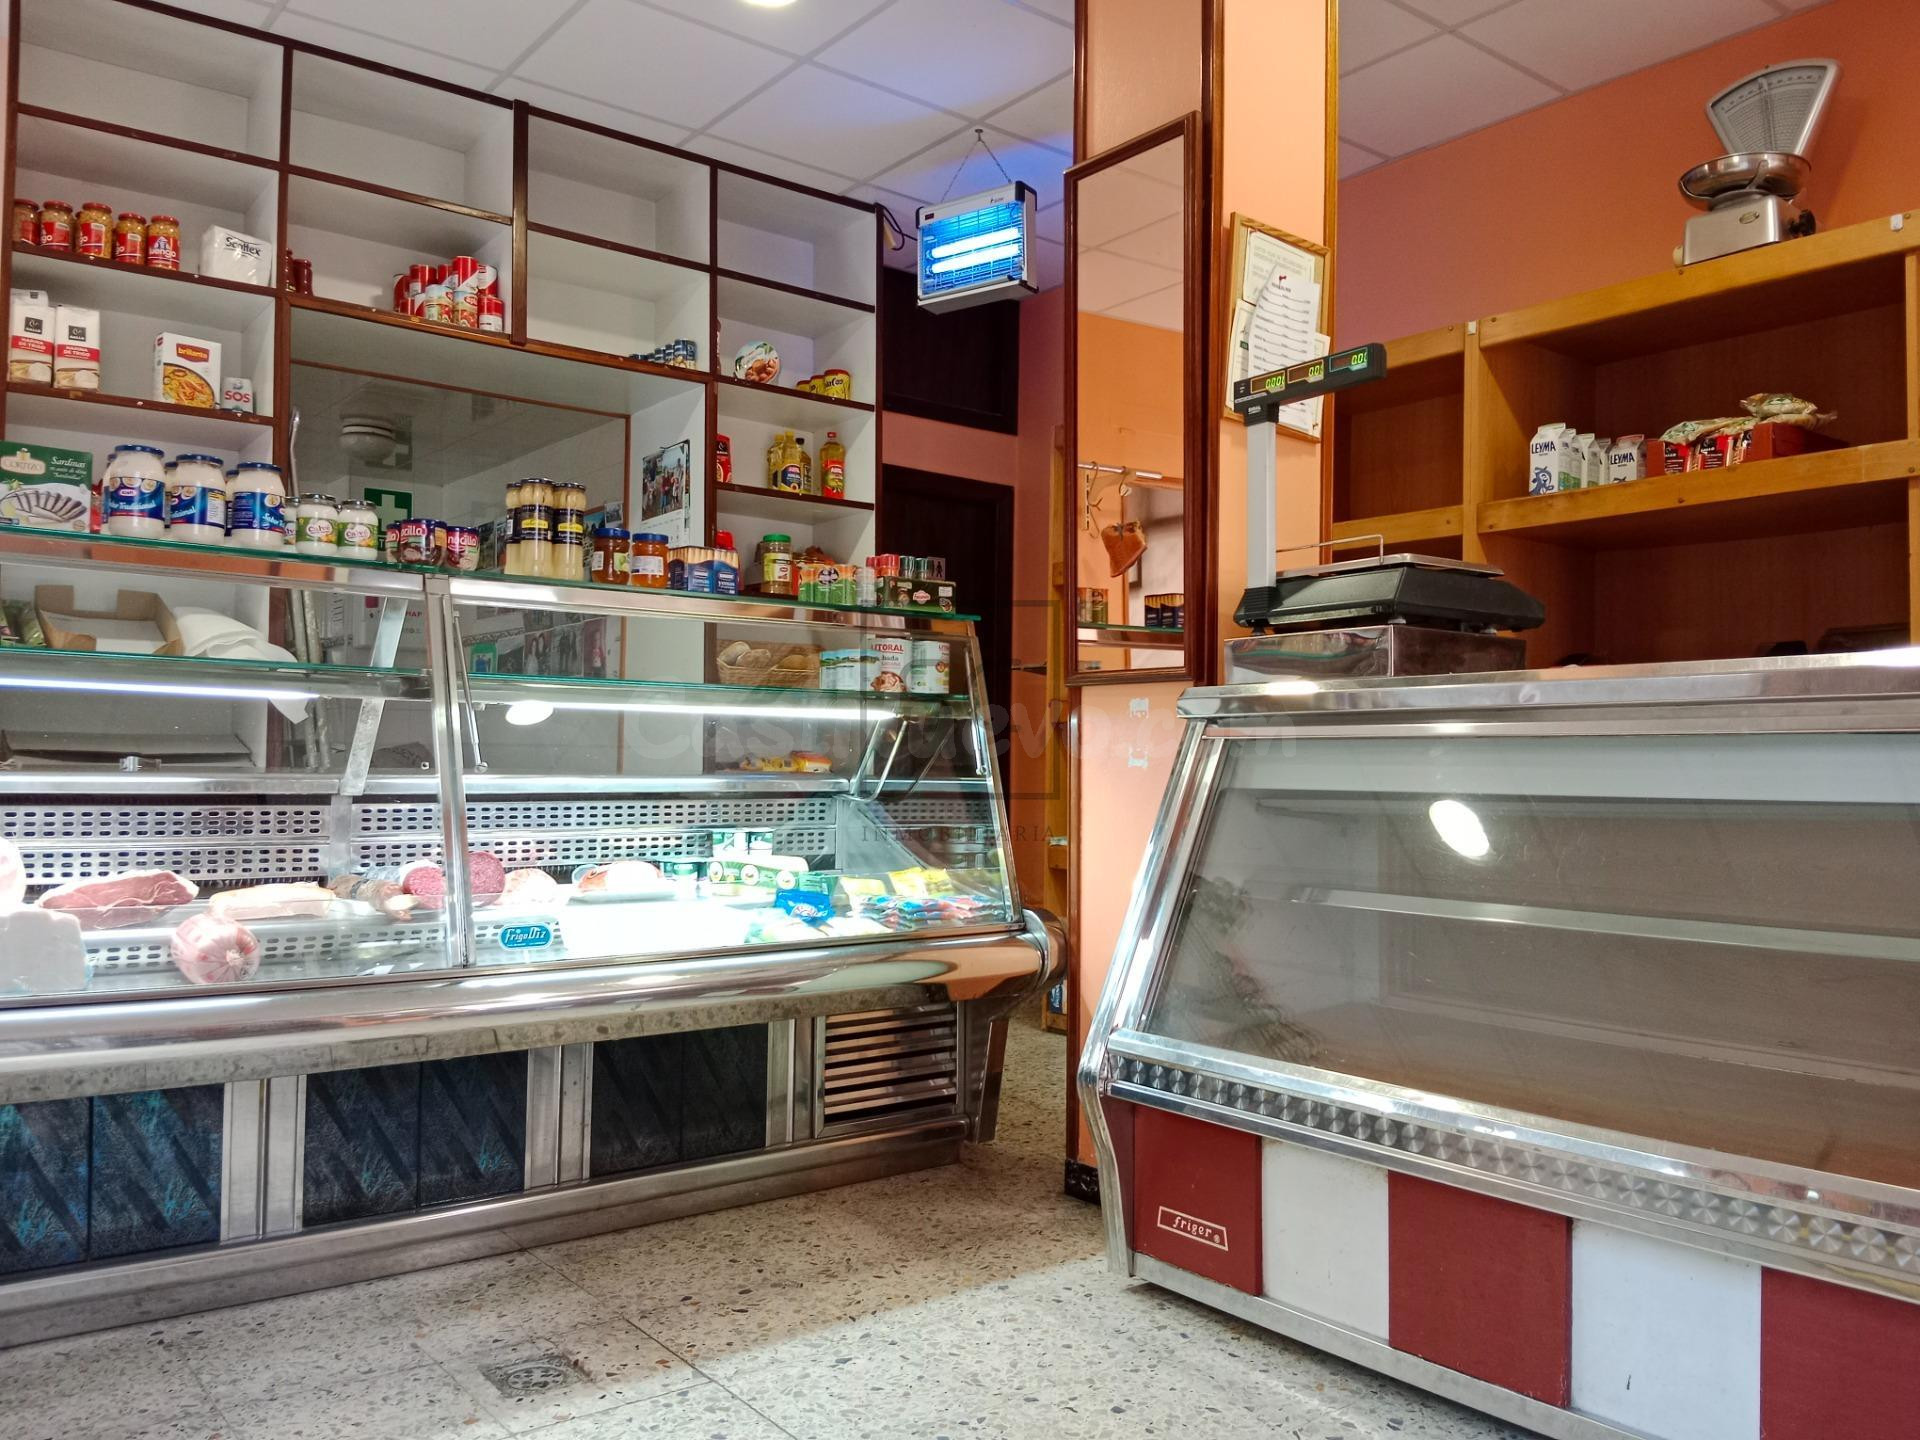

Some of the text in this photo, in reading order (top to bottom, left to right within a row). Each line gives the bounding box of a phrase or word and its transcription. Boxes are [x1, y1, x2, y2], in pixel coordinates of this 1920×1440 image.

[224, 390, 251, 403] SOS
[1531, 440, 1556, 454] LEYMA
[1610, 452, 1635, 465] LEYMA
[447, 534, 478, 547] nocilla
